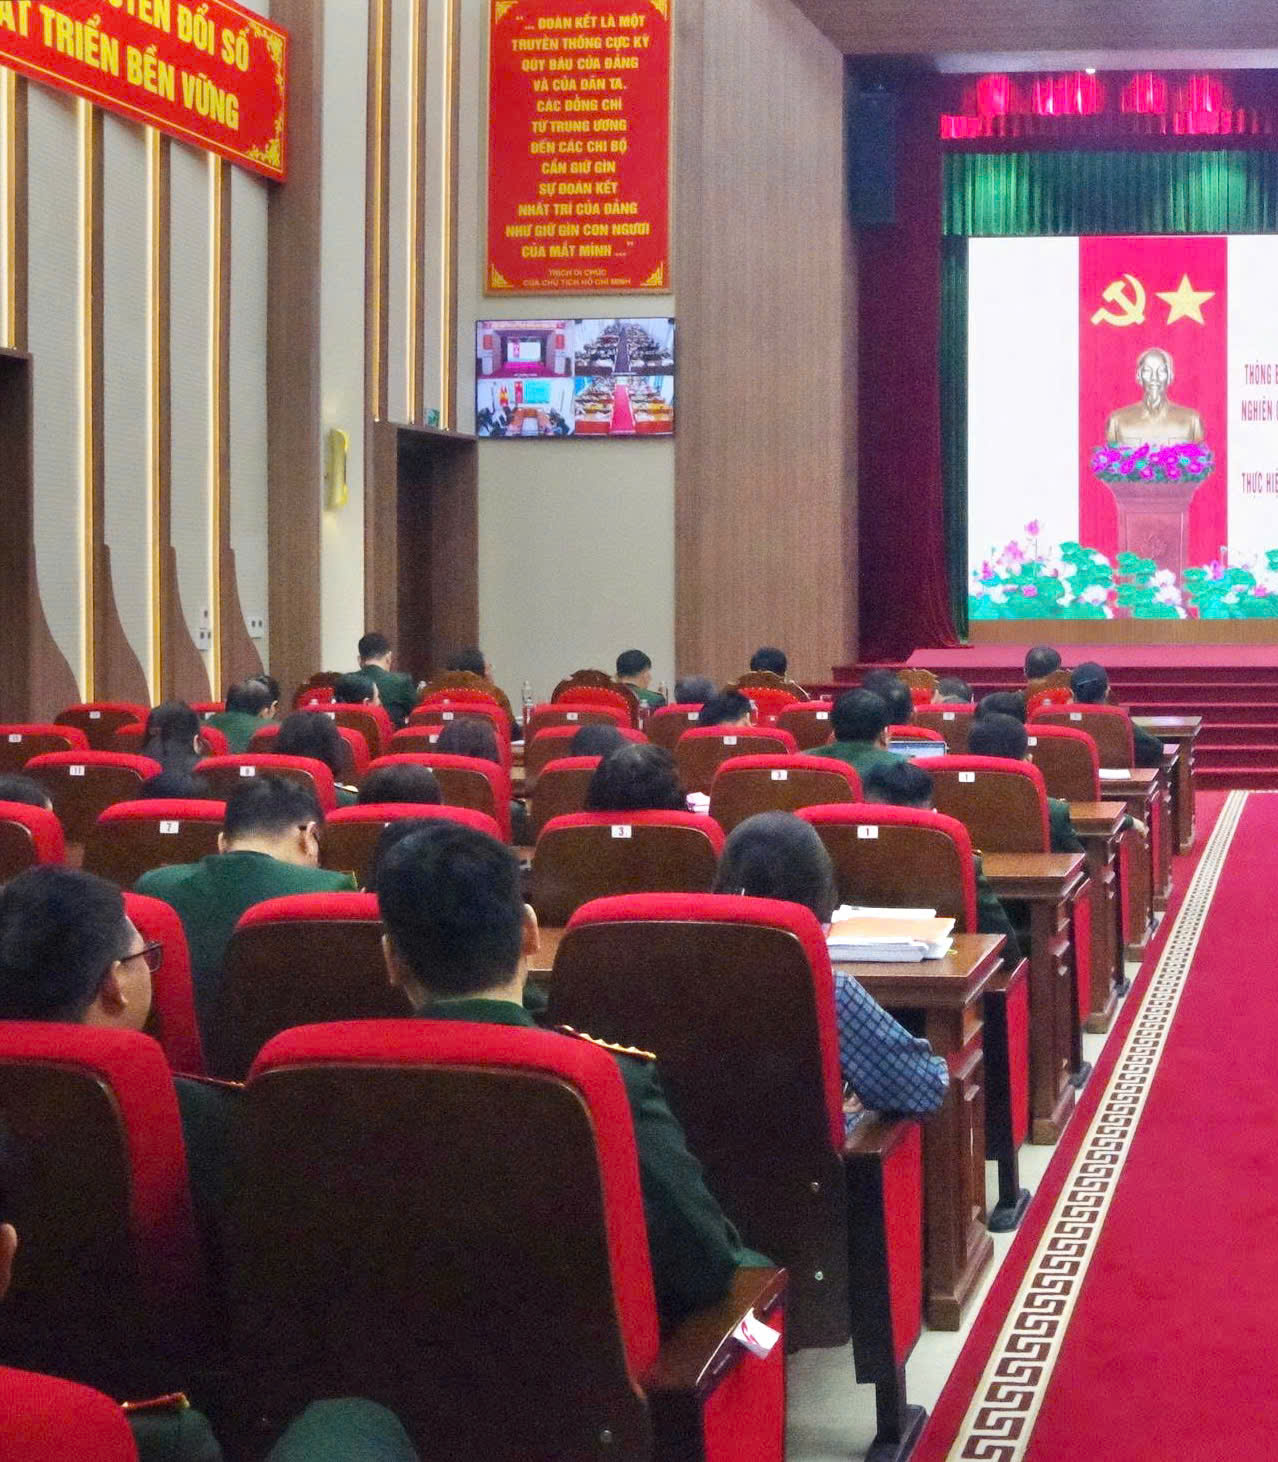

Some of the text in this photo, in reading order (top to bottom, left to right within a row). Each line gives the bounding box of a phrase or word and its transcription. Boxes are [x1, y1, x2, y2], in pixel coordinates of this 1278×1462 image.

[177, 3, 215, 56] ĐỔI
[221, 26, 250, 72] SỐ
[40, 5, 119, 77] TRIỂN
[127, 44, 175, 102] BỀN
[182, 71, 239, 130] VỮNG
[548, 119, 591, 133] TRUNG
[586, 139, 608, 153] CHI
[582, 223, 610, 237] CON
